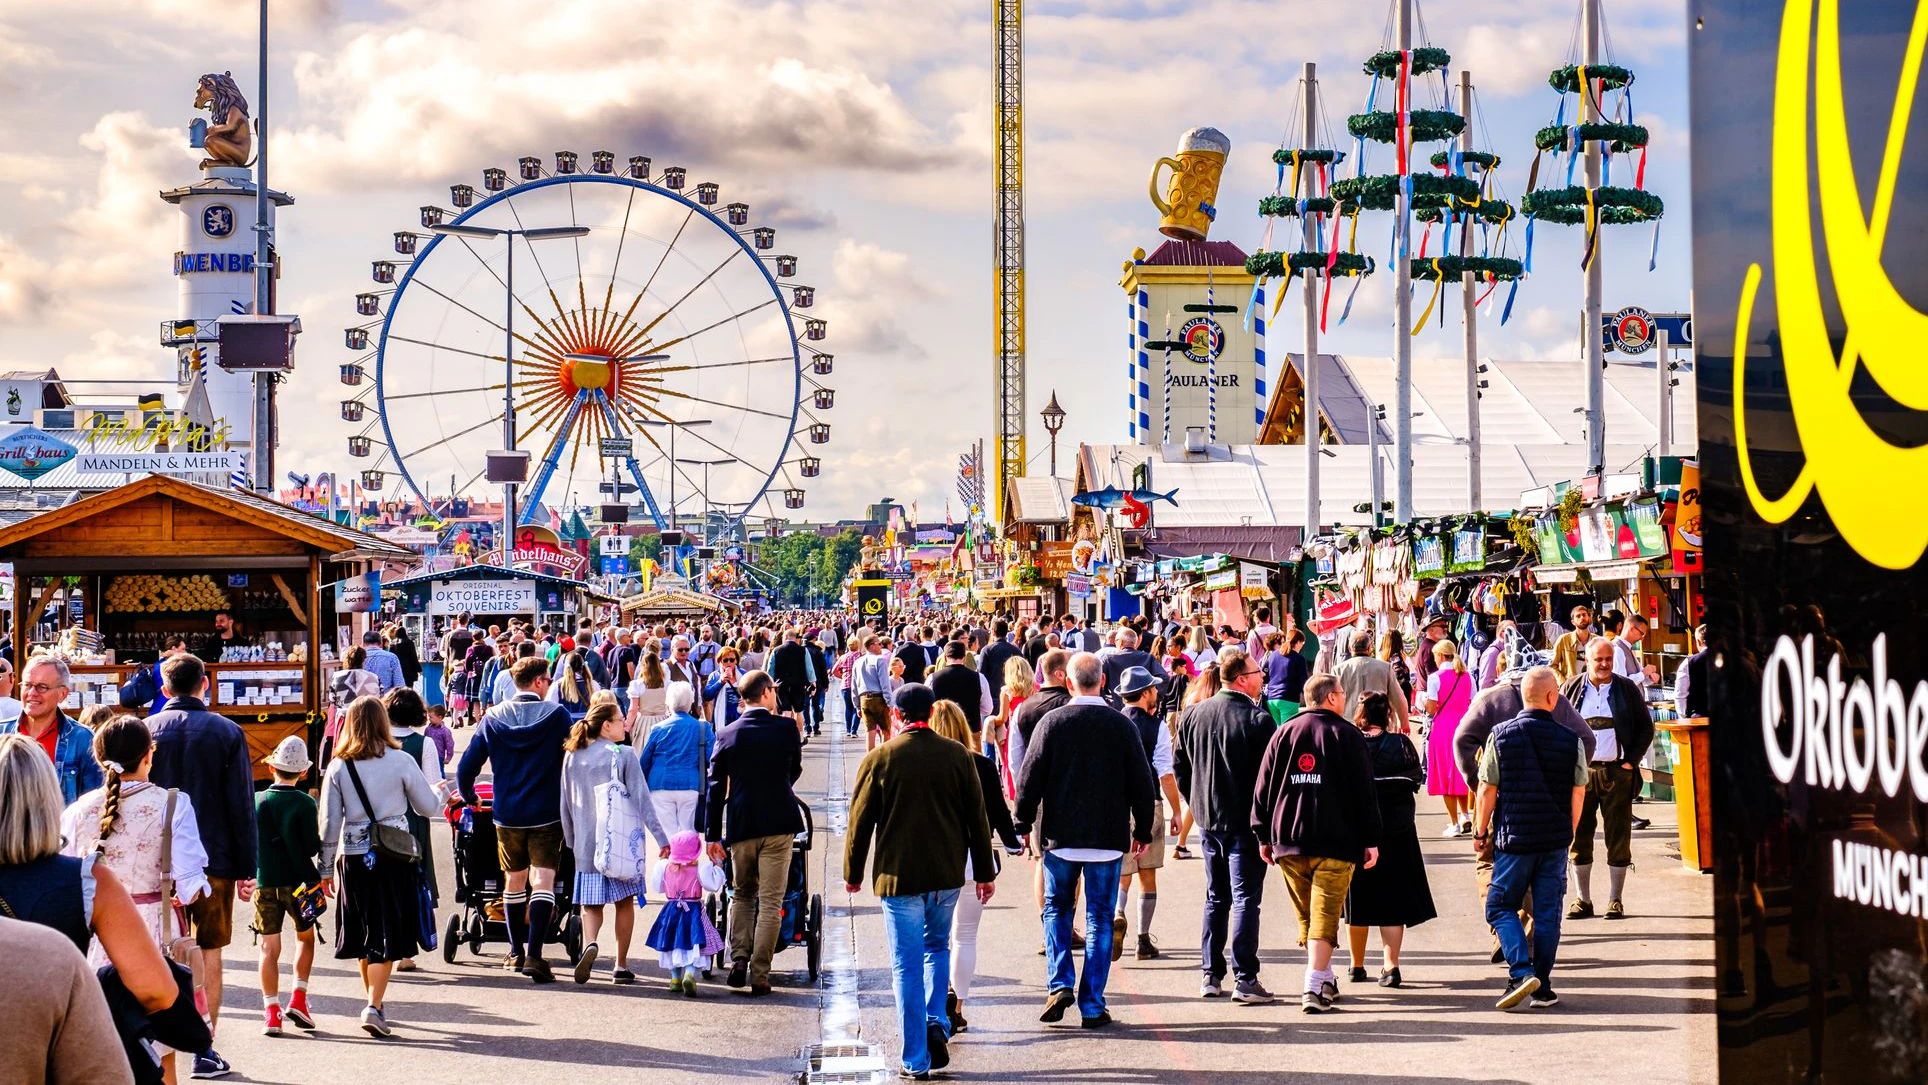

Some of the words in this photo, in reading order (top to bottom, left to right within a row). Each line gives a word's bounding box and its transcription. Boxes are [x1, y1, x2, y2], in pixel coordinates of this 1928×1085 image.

[1612, 308, 1654, 328] PAULANER
[1181, 318, 1222, 335] PAULAER
[83, 458, 161, 470] MANDELN
[167, 456, 179, 469] &
[184, 457, 231, 469] MEHR
[436, 590, 531, 601] OKTOBERFEST
[448, 602, 519, 611] SOUVENIRS
[1762, 632, 1928, 803] Oktobe
[1290, 773, 1322, 785] YAMAHA
[1832, 839, 1928, 920] MÜNCH
